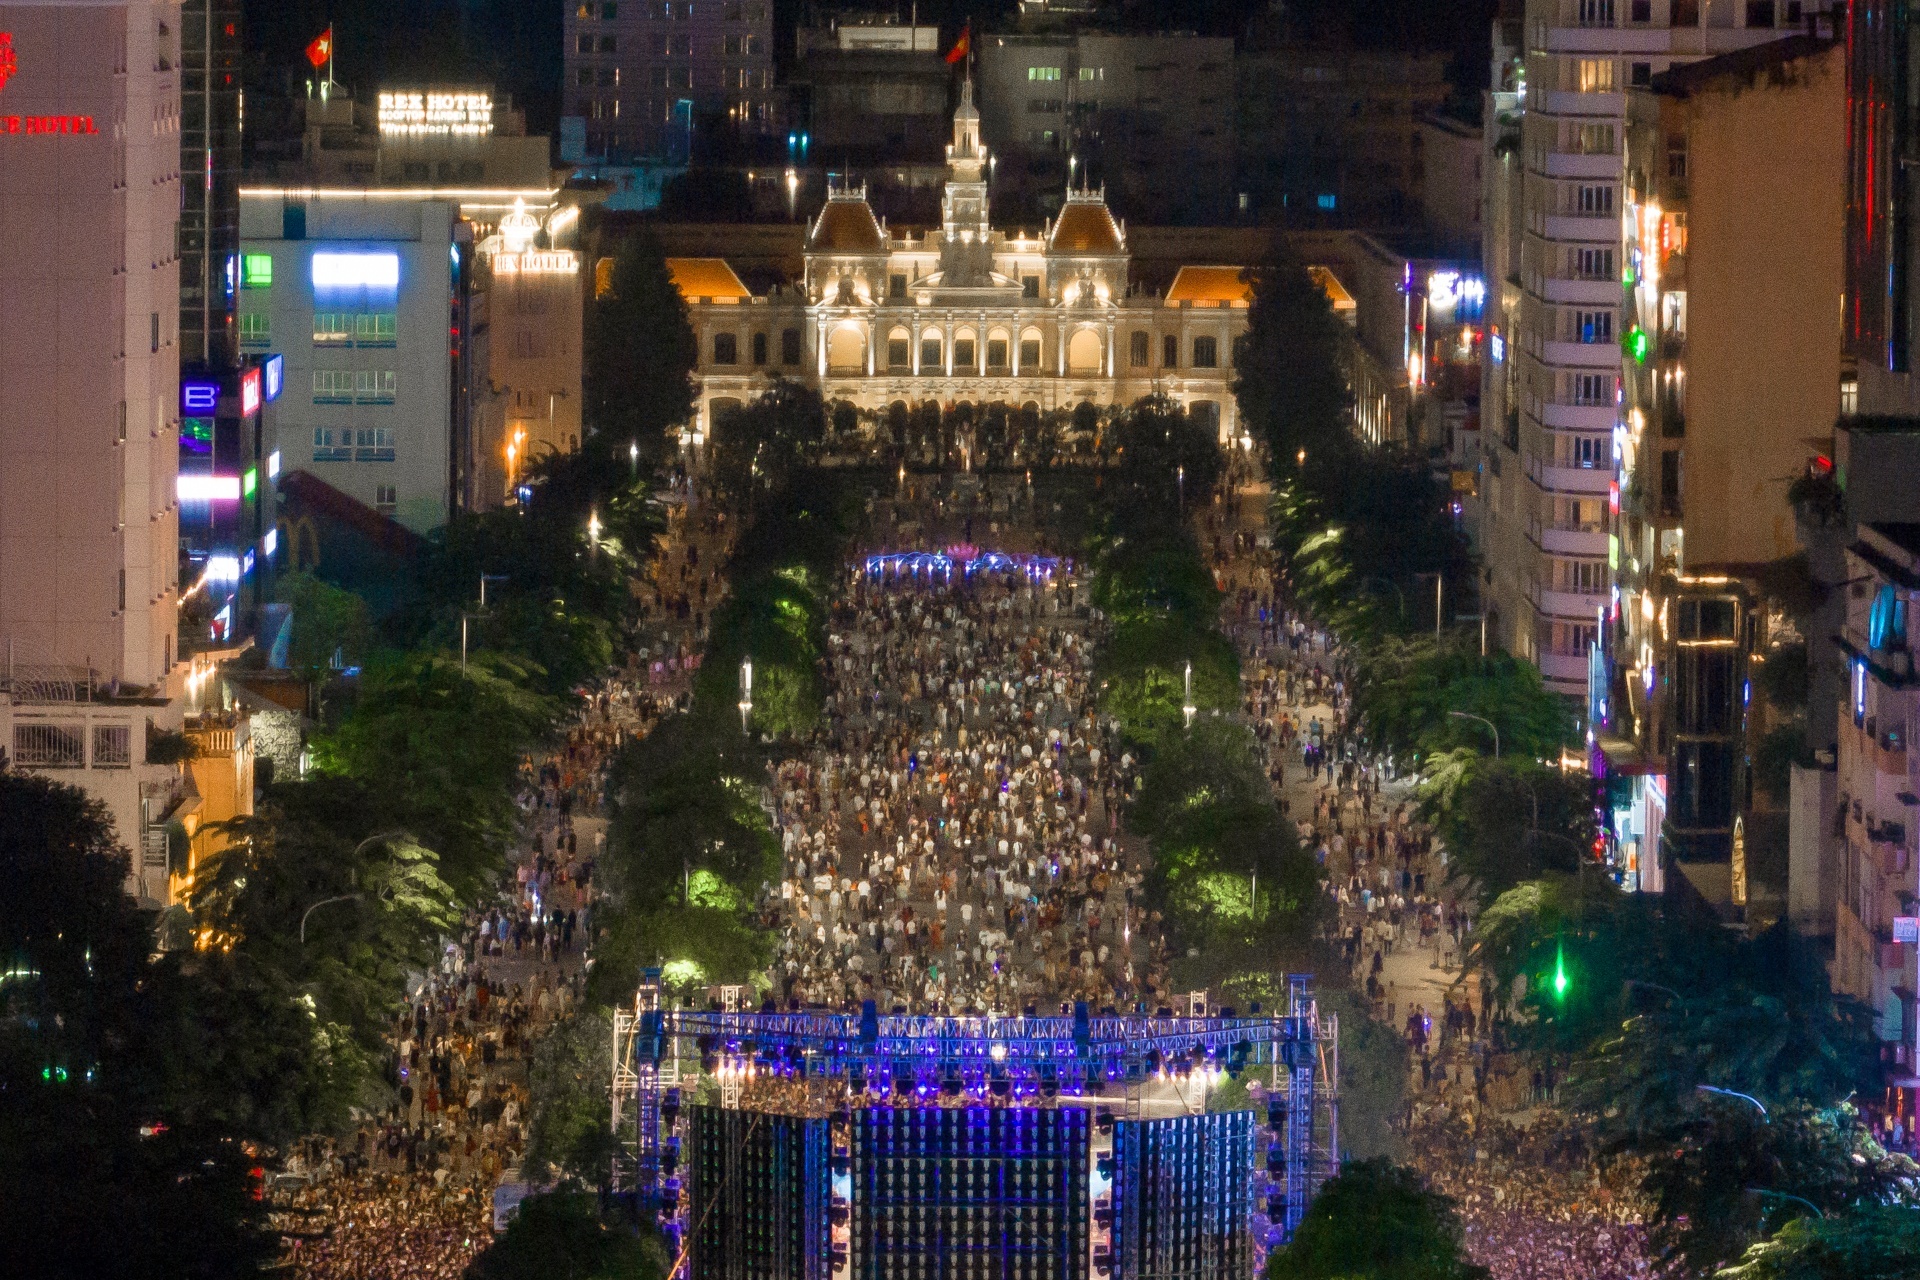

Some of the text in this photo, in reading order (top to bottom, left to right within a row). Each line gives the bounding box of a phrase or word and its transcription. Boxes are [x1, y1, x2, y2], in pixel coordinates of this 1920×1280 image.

[379, 94, 493, 110] REX HOTEL
[26, 115, 99, 135] HOTEL
[379, 110, 490, 122] ROOFTOP GARDEN BAR
[495, 252, 579, 274] REX HOTEL
